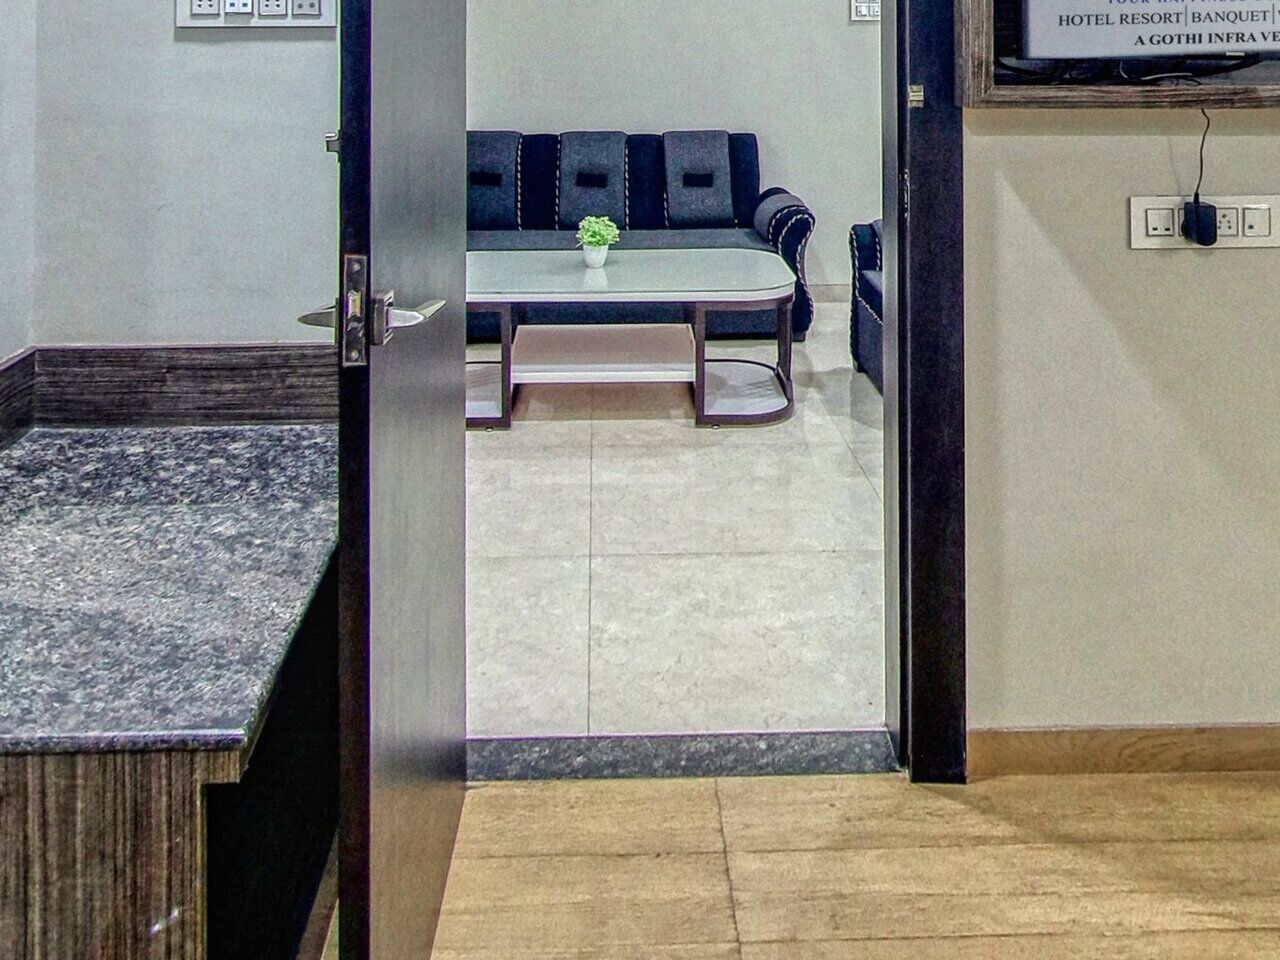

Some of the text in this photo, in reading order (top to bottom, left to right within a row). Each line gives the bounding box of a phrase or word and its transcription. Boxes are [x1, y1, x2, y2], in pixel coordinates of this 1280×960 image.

[1058, 13, 1114, 27] HOTEL
[1119, 12, 1183, 25] RESORT
[1191, 9, 1270, 25] BANQUET
[1134, 35, 1145, 46] A
[1149, 33, 1203, 45] GOTHI
[1208, 31, 1256, 43] INFRA
